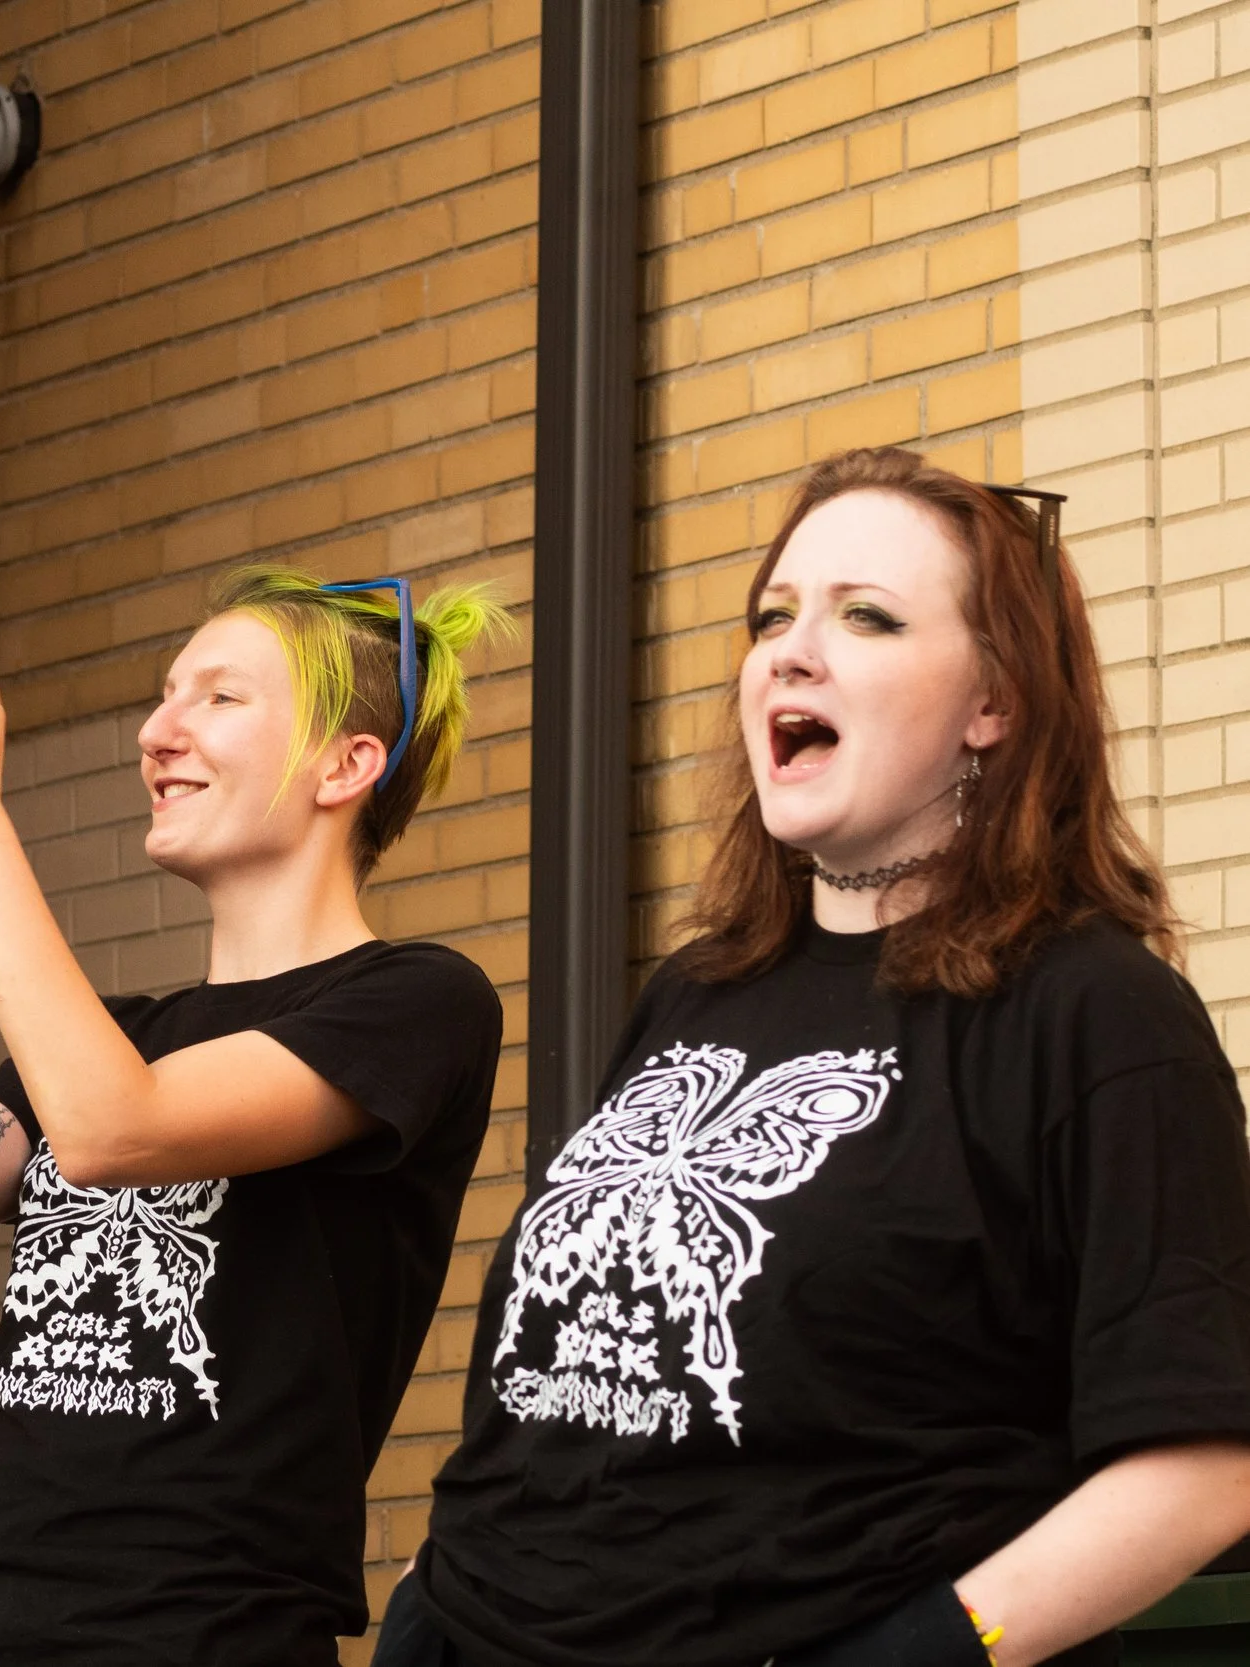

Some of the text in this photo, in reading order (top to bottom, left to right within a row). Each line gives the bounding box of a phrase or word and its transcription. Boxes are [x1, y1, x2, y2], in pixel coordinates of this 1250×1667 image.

[46, 1311, 131, 1340] GIRLS
[578, 1291, 655, 1334] GLS
[10, 1331, 133, 1375] ROCK
[549, 1319, 661, 1383] RCK
